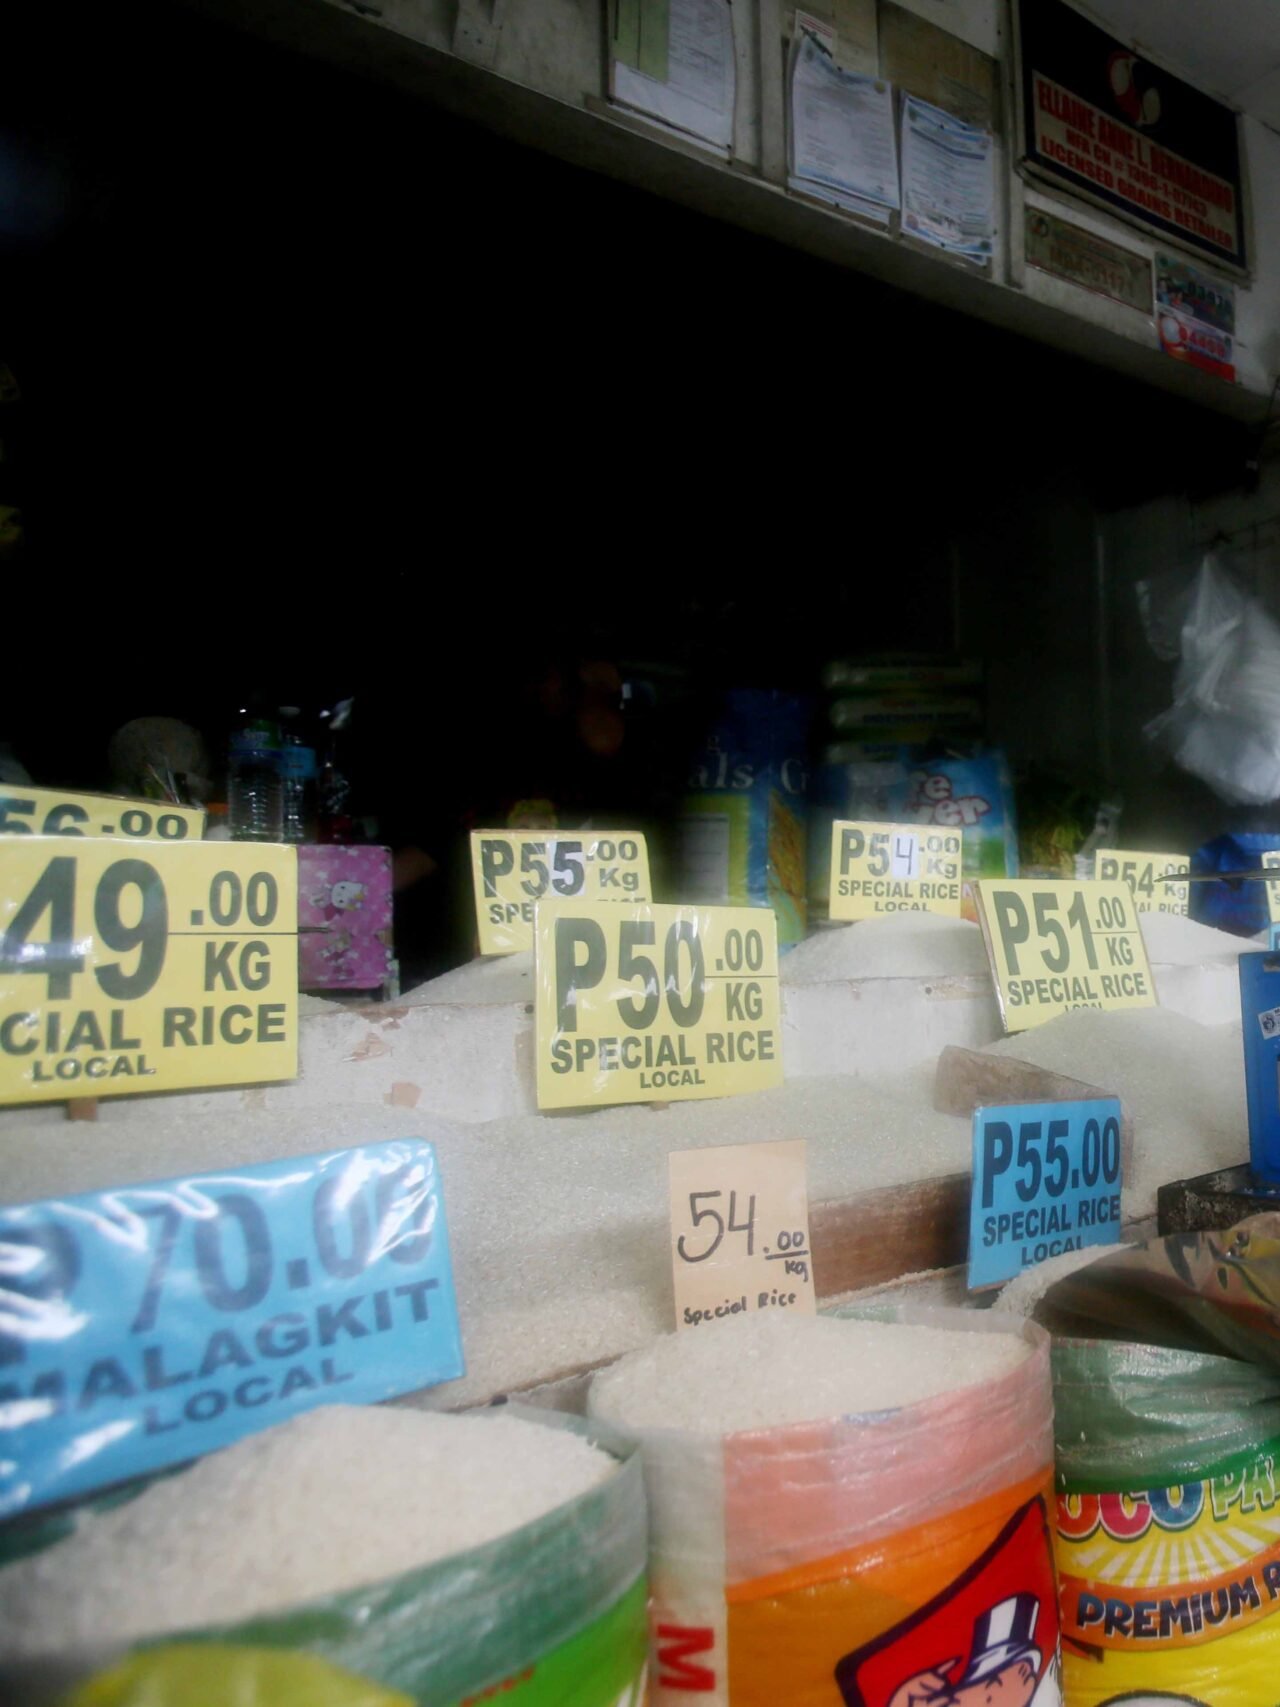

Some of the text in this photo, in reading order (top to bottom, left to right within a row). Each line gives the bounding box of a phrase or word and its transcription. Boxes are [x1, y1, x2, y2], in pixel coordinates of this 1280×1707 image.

[599, 868, 640, 892] Kg
[838, 880, 914, 899] SPECIAL
[919, 882, 959, 900] RICE
[874, 901, 931, 912] LOCAL
[203, 940, 272, 992] KG
[1105, 935, 1135, 967] KG
[725, 982, 763, 1022] KG
[1006, 971, 1148, 1007] SPECIAL RICE
[162, 1003, 287, 1048] RICE
[33, 1054, 157, 1082] LOCAL
[550, 1029, 775, 1075] SPECIAL RICE
[639, 1068, 706, 1089] LOCAL
[981, 1115, 1121, 1210] P55.00
[982, 1194, 1121, 1249] SPECIAL RICE
[1021, 1235, 1084, 1266] LOCAL
[682, 1288, 797, 1327] Special Rice
[143, 1357, 355, 1436] LOCAL
[1076, 1576, 1262, 1640] PREMIUM
